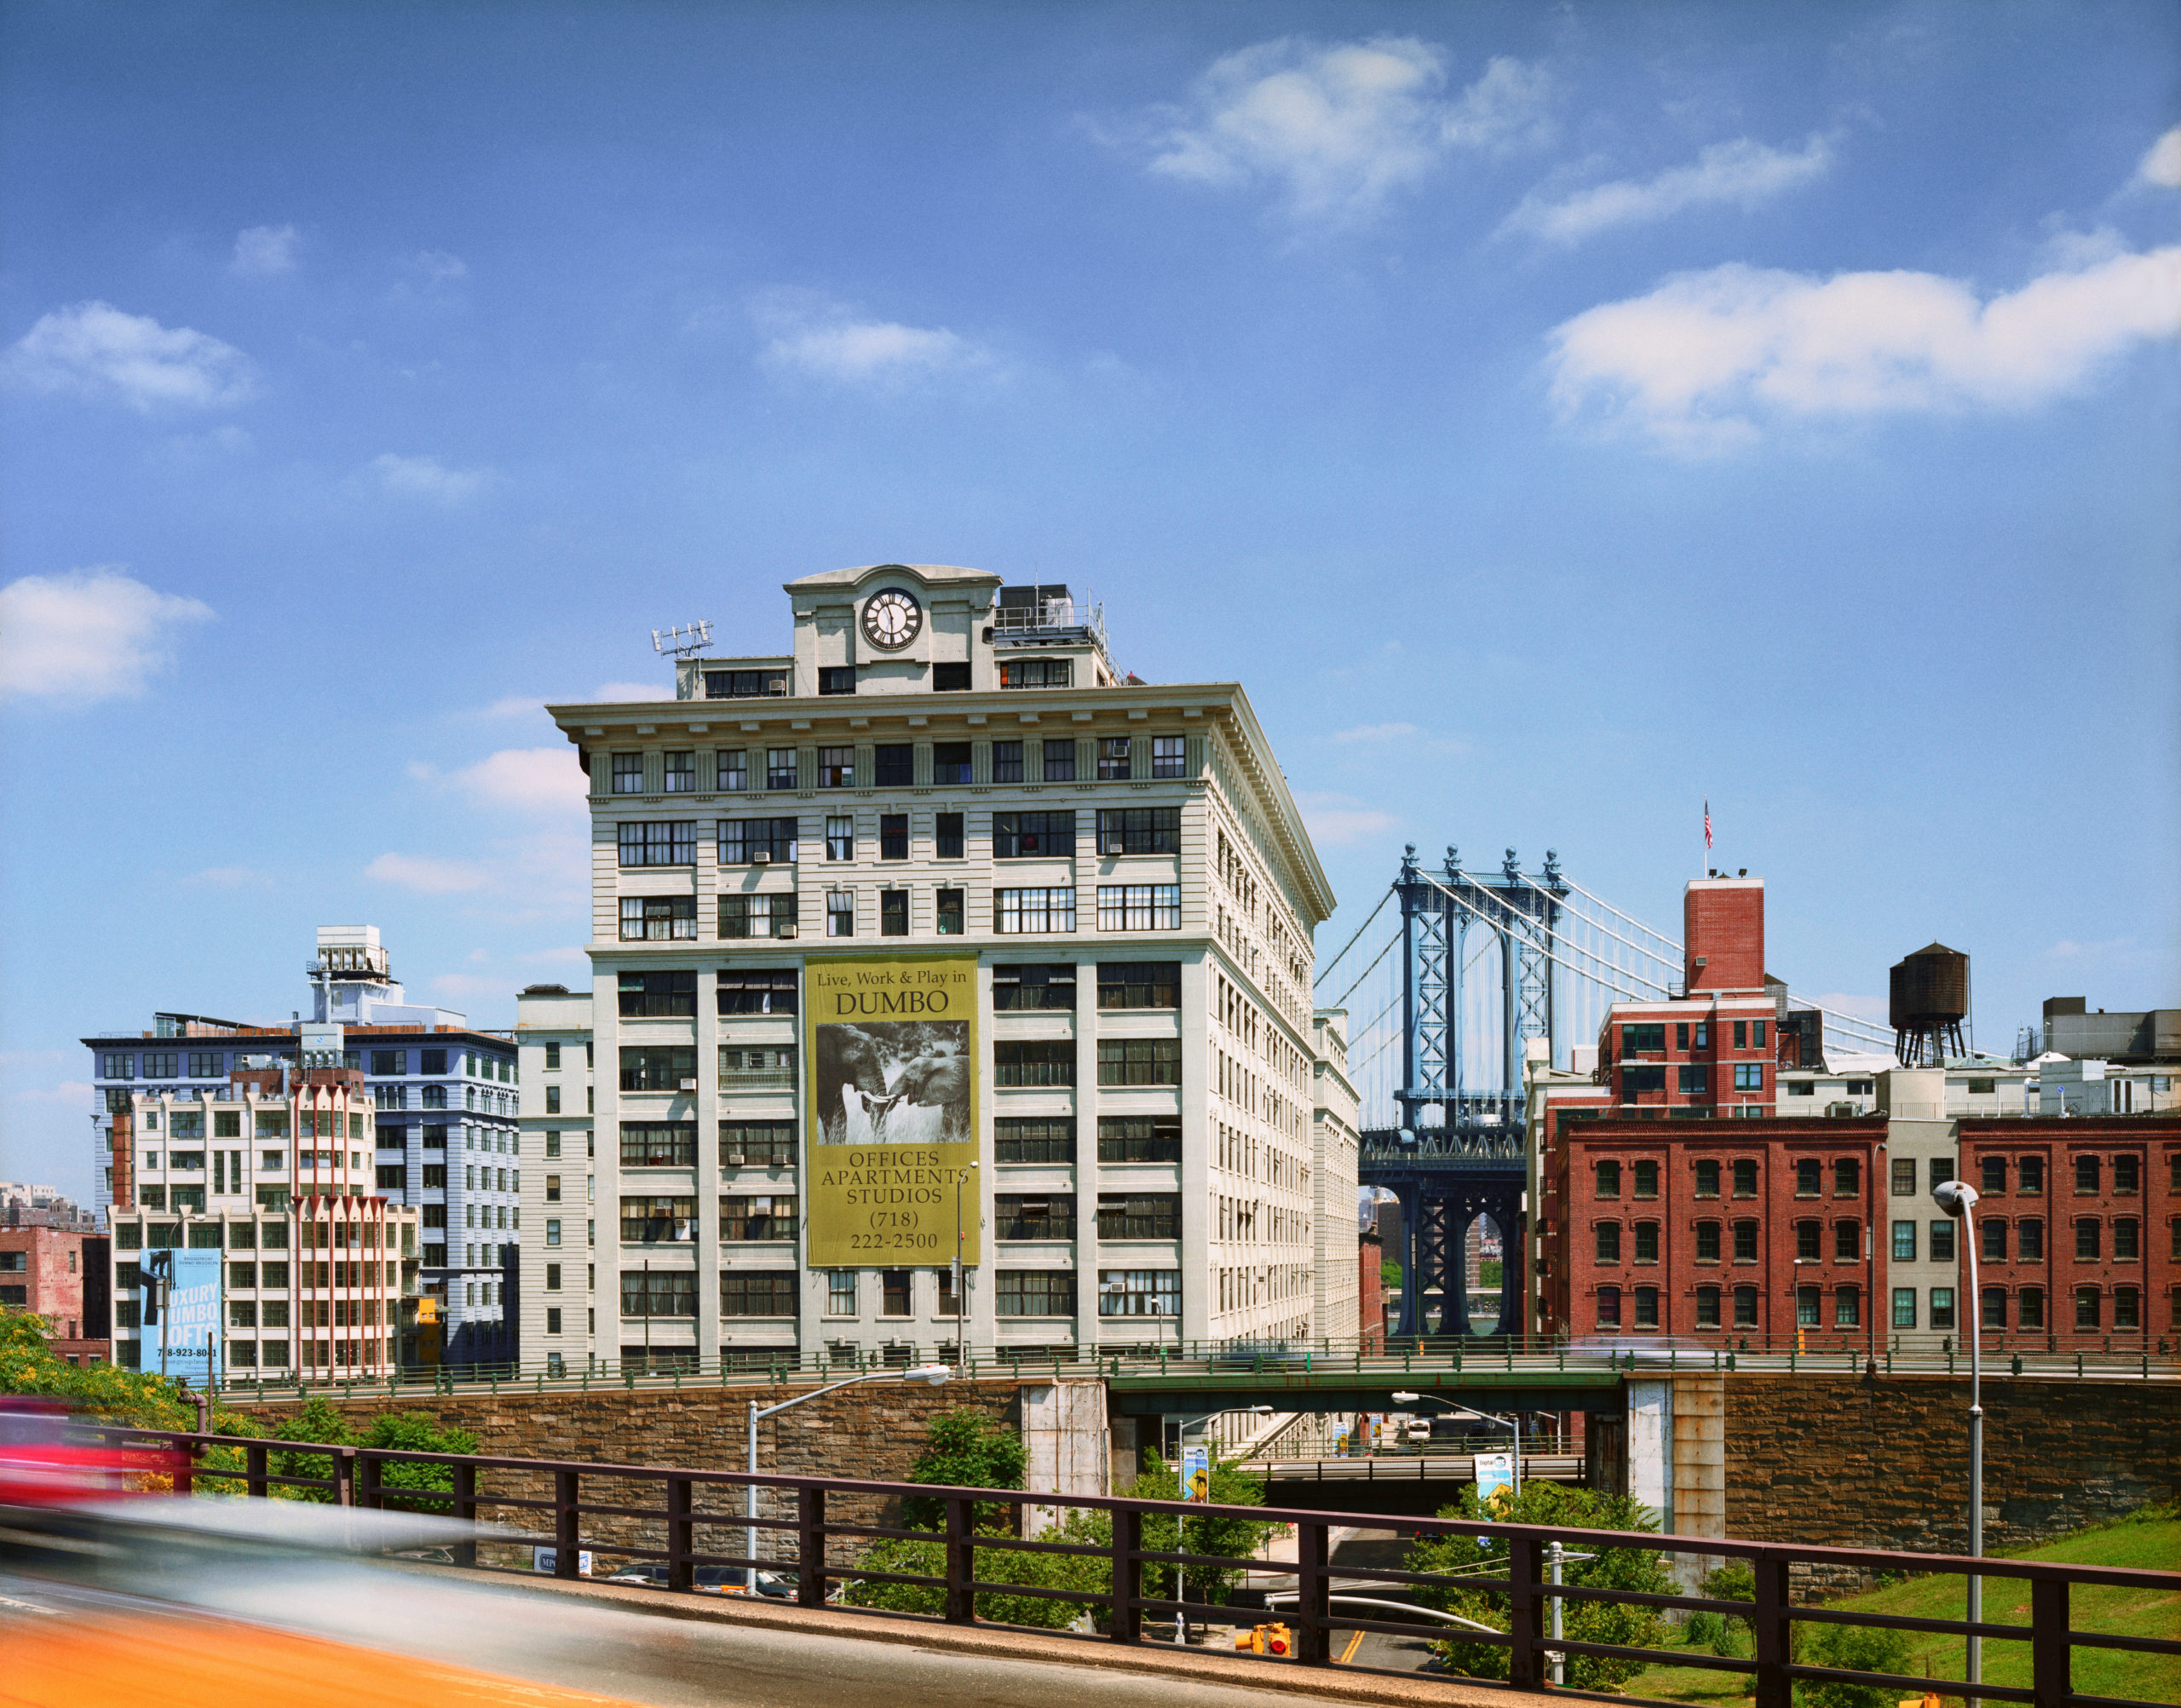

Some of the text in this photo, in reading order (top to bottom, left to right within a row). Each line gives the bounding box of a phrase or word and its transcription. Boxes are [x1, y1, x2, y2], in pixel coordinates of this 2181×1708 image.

[817, 970, 967, 987] Live, Work & Play in
[835, 990, 949, 1015] DUMBO
[849, 1151, 940, 1167] OFFICES
[821, 1169, 969, 1185] APARTMENTS
[847, 1188, 942, 1204] STUDIOS
[870, 1211, 919, 1229] (718)
[851, 1234, 938, 1249] 222-2500
[169, 1283, 218, 1308] UXURY
[158, 1349, 217, 1357] 78-923-801
[542, 1557, 555, 1567] MP
